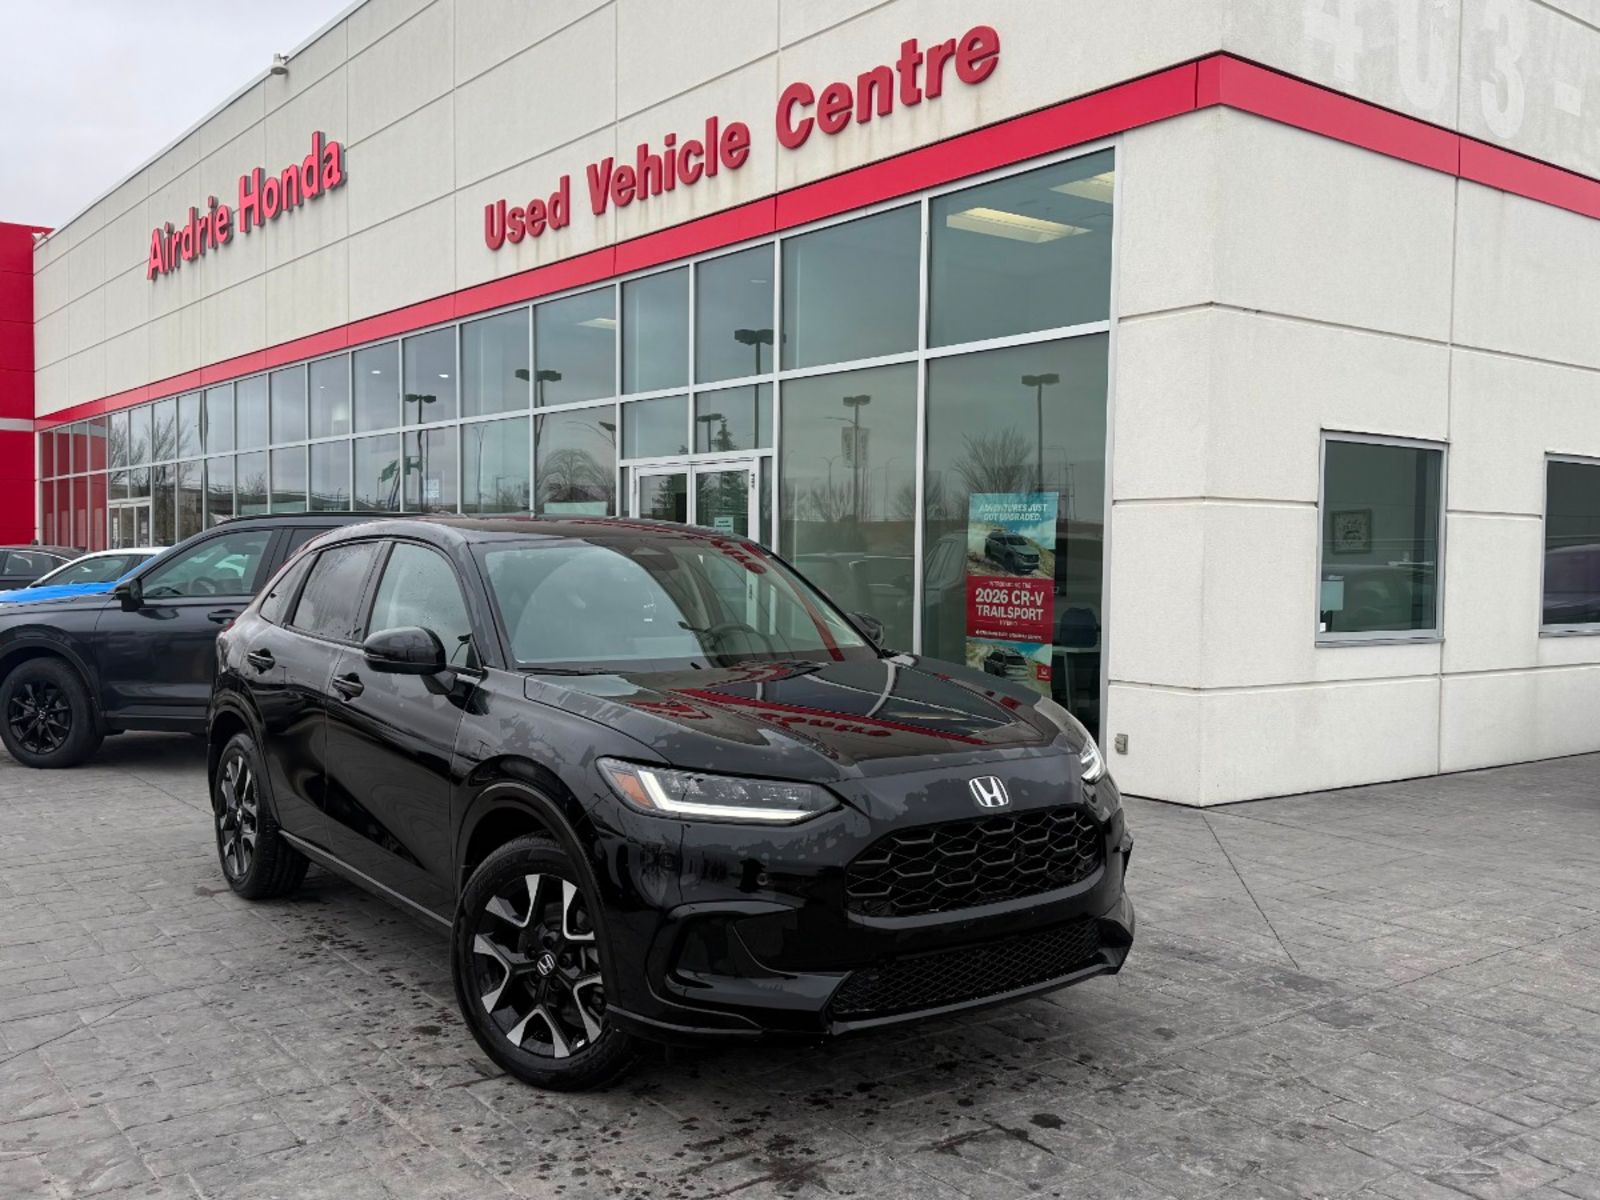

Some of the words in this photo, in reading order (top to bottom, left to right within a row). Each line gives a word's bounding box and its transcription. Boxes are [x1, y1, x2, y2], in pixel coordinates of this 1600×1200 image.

[484, 175, 570, 250] Used
[586, 115, 750, 216] Vehicle
[775, 25, 1000, 149] Centre
[147, 196, 233, 280] Airdrie
[238, 130, 347, 233] Honda
[984, 512, 998, 521] GOT
[1028, 503, 1048, 513] JUST
[975, 587, 1009, 604] 2026
[1011, 590, 1045, 606] CR-V
[975, 604, 1044, 621] TRAILSPORT
